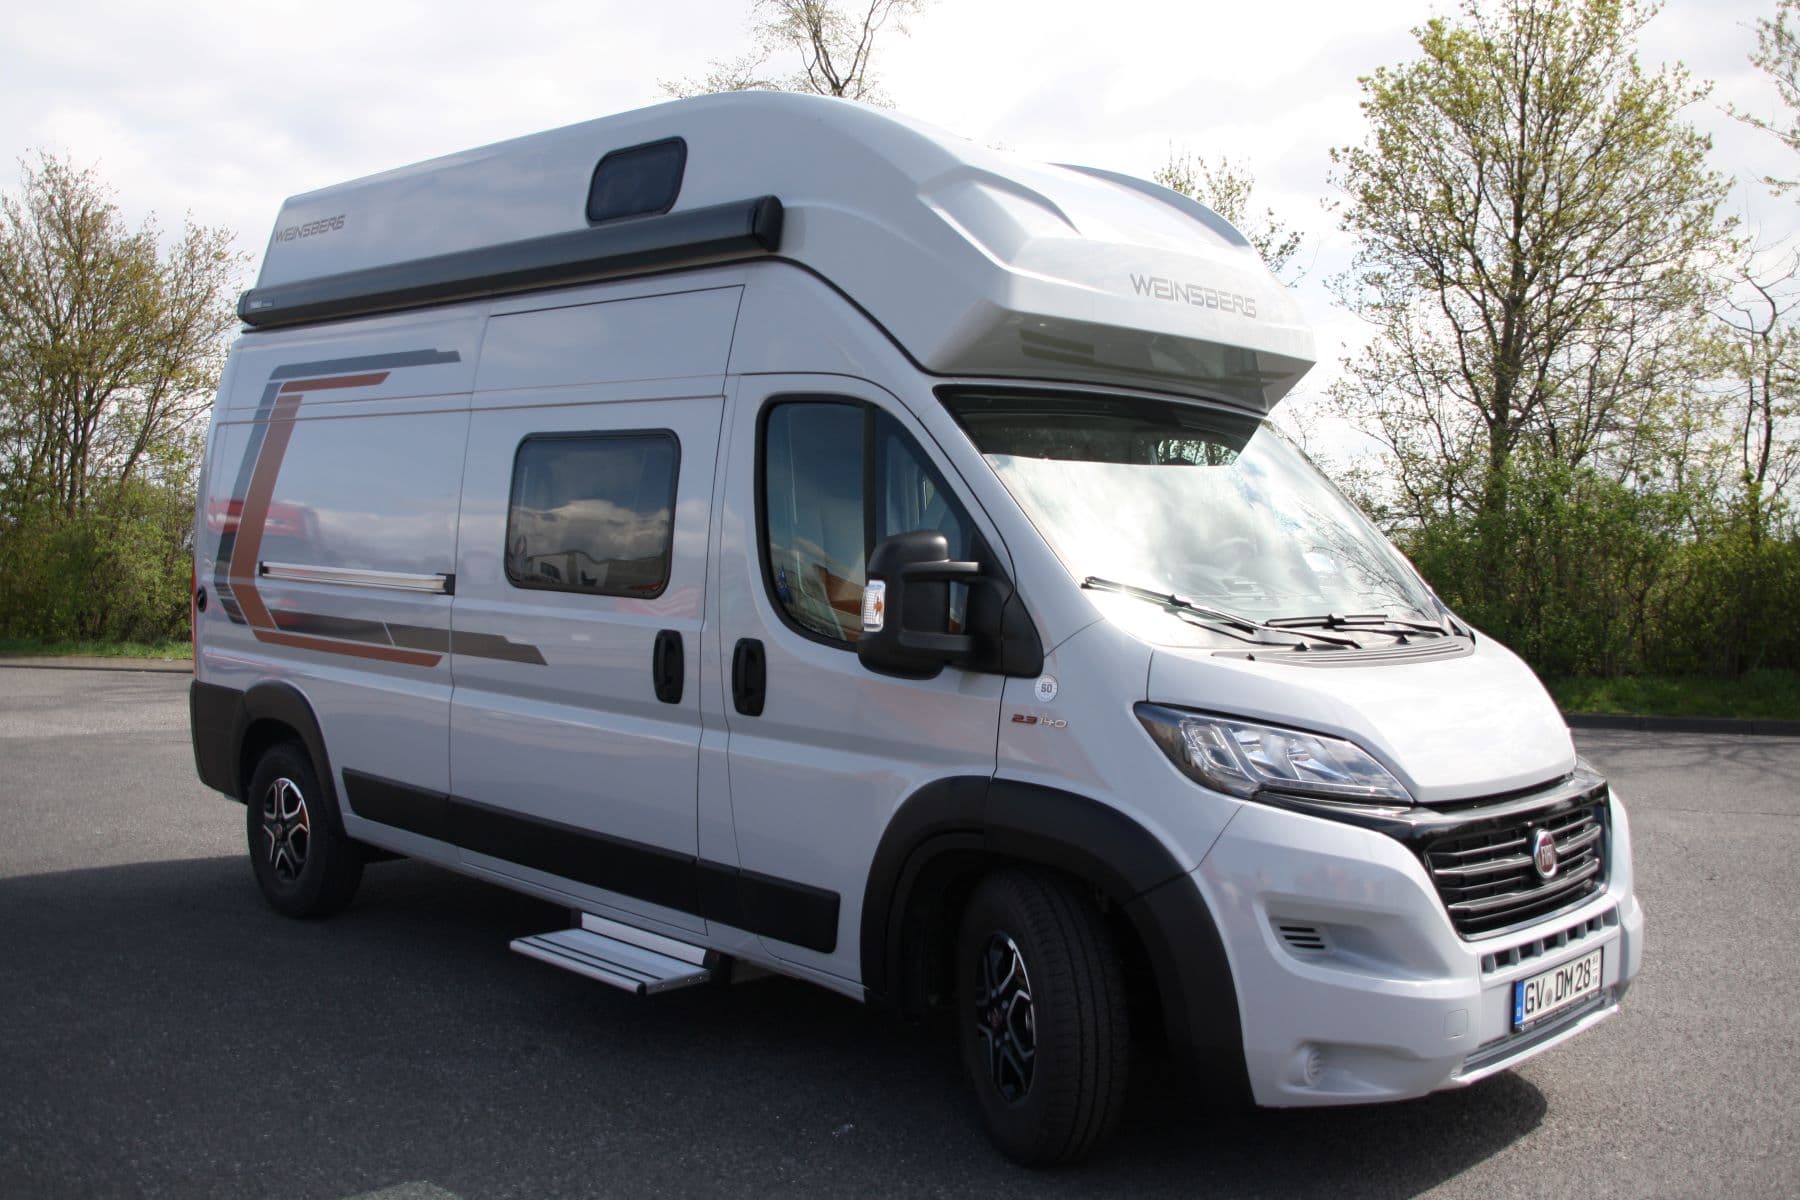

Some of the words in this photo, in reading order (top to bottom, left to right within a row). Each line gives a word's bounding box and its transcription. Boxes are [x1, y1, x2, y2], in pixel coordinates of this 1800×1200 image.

[275, 214, 346, 242] WEINSBERG
[1130, 273, 1256, 318] WEINSBERG
[1041, 684, 1052, 693] 50
[1525, 978, 1545, 1014] GV
